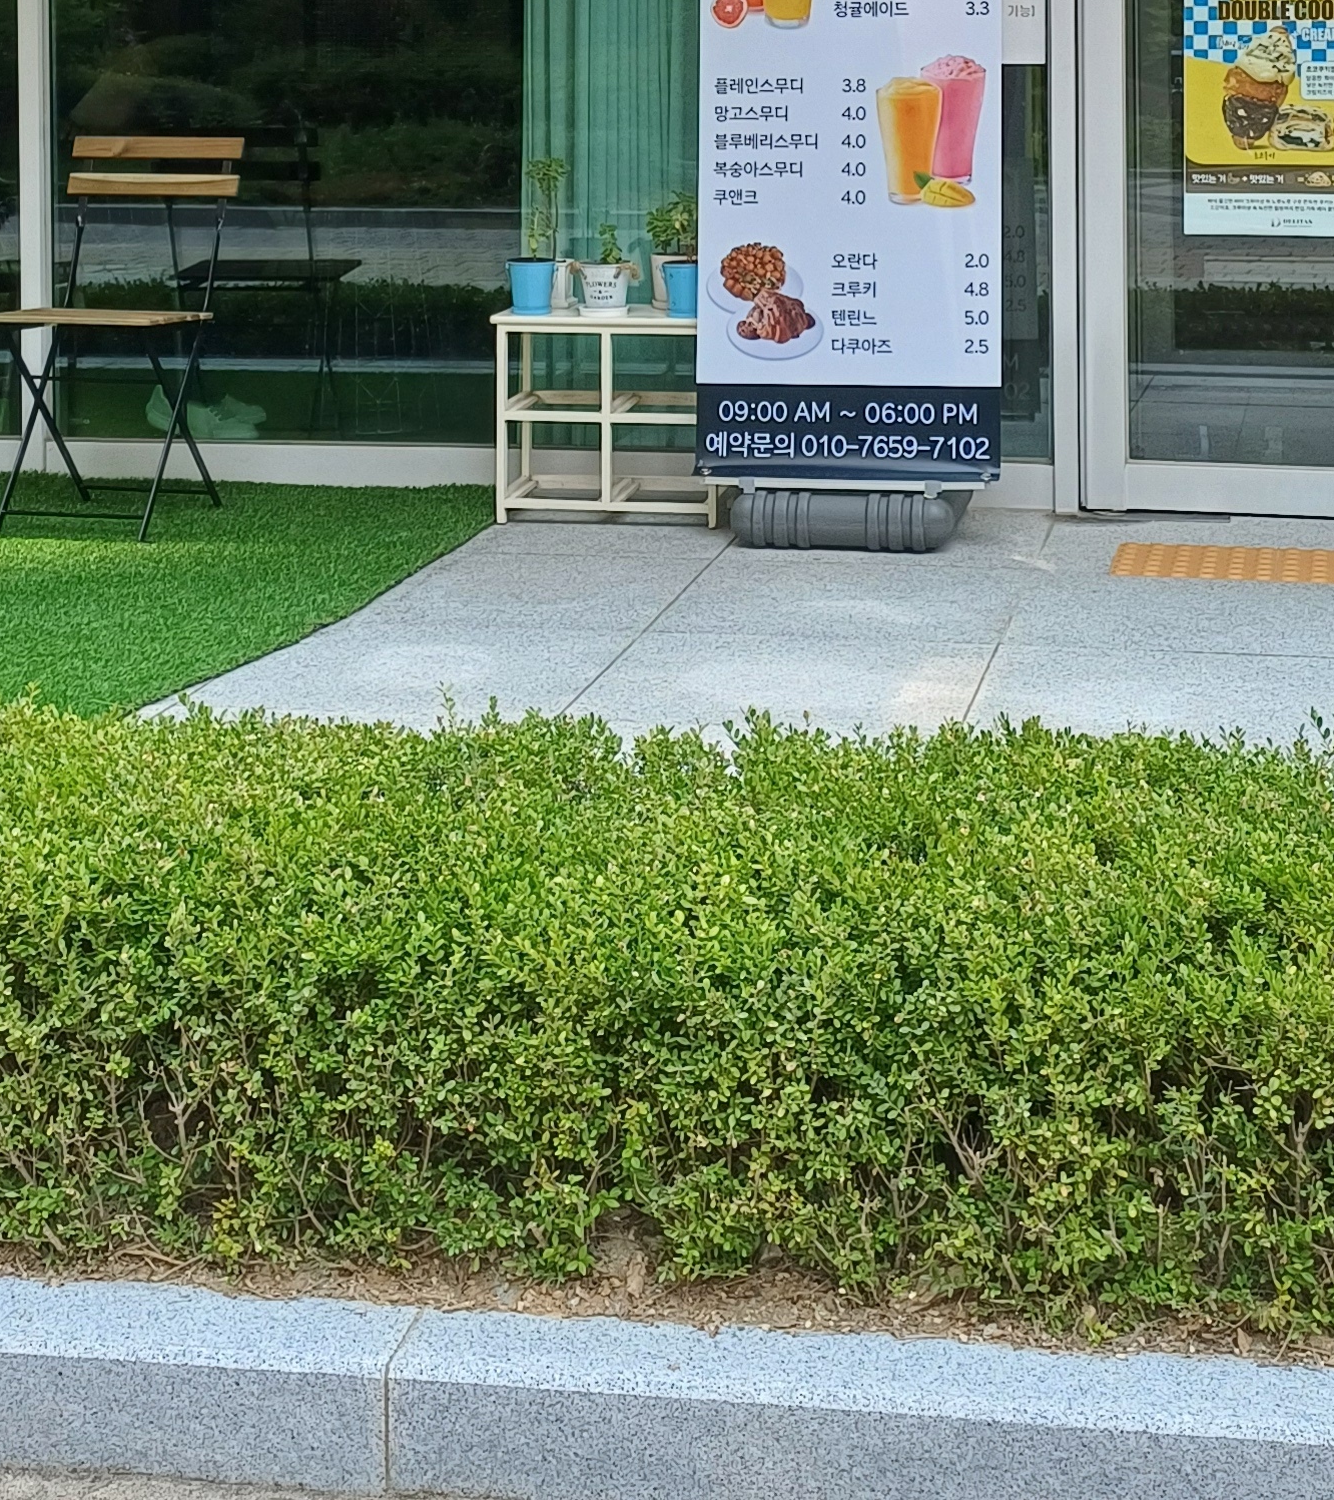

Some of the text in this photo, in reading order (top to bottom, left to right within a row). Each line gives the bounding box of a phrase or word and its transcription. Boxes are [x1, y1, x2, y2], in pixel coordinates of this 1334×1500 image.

[833, 1, 990, 18] 청귤에이드 3.3
[1218, 0, 1290, 20] DOUBLE
[714, 77, 866, 94] 플레인스무디 3.8
[714, 105, 866, 122] 망고스무디 4.0
[713, 133, 866, 151] 블루베리스무디 4.0
[713, 161, 866, 178] 복숭아스무디 4.0
[713, 189, 866, 206] 쿠앤크 4.0
[831, 253, 989, 270] 오란다 2.0
[831, 281, 989, 298] 크루키 4.8
[831, 310, 989, 327] 텐린느 5.0
[831, 338, 989, 355] 다쿠아즈 2.5
[718, 400, 788, 422] 09:00
[794, 401, 831, 423] AM
[865, 402, 935, 425] 06:00
[942, 403, 978, 425] PM
[705, 432, 991, 460] 예약문의 010-7659-7102
